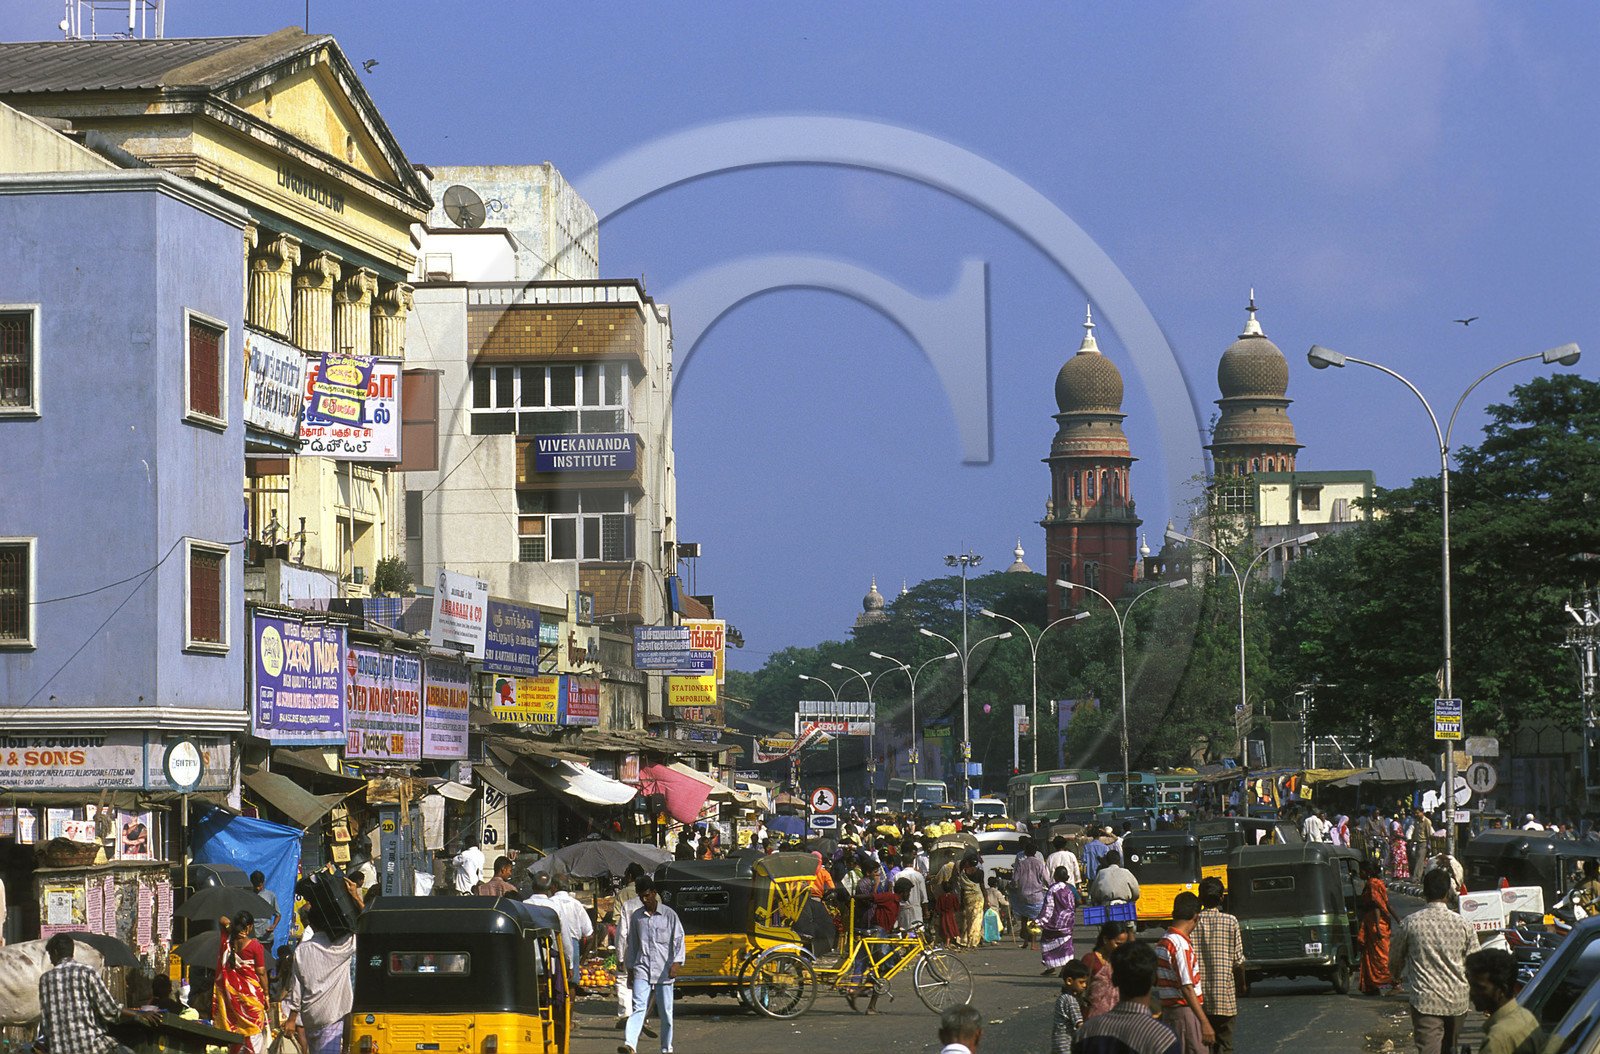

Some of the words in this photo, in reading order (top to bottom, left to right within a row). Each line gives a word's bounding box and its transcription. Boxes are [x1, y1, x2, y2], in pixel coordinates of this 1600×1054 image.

[539, 438, 631, 452] VIVEKANANDA
[553, 455, 617, 468] INSTITUTE
[313, 638, 340, 675] INDIA
[486, 649, 494, 660] SRI
[671, 684, 714, 692] STATIONERY
[347, 684, 367, 712] SYED
[392, 688, 420, 716] STORES
[426, 685, 449, 708] ABBAS
[675, 695, 711, 703] EMPORIUM
[494, 711, 524, 722] VIJAYA
[526, 712, 556, 723] STORE
[818, 723, 844, 731] SERVO
[1437, 723, 1459, 732] NIIT
[7, 751, 19, 766] &
[24, 750, 86, 767] SONS
[386, 861, 395, 872] NO
[1484, 922, 1502, 930] 7111
